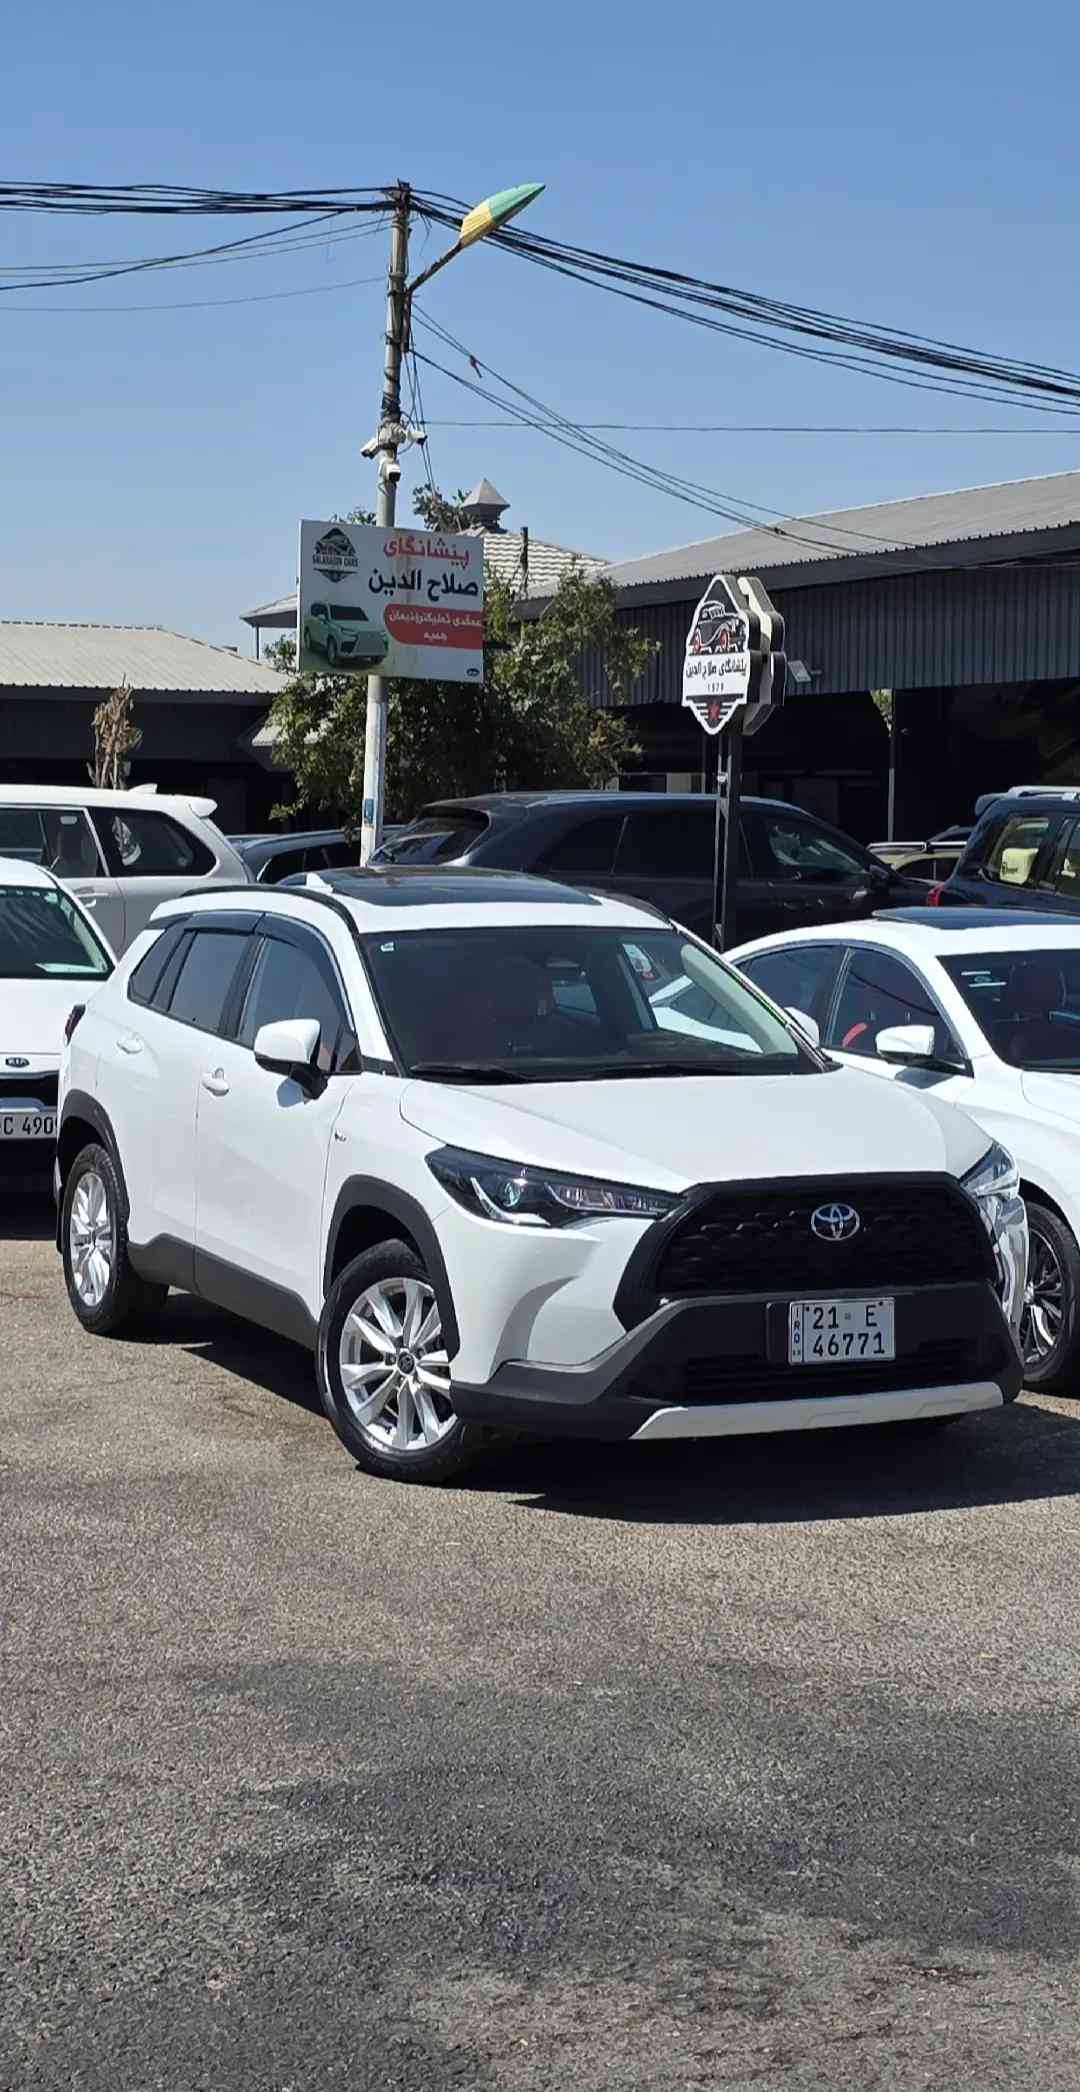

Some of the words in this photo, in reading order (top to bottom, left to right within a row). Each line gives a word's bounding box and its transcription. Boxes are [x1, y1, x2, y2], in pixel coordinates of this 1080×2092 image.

[427, 571, 479, 601] صلاح
[6, 1057, 29, 1067] KIA
[4, 1117, 14, 1135] C
[22, 1117, 57, 1135] 490
[813, 1307, 839, 1330] 21
[866, 1305, 878, 1327] E
[813, 1331, 885, 1357] 46771
